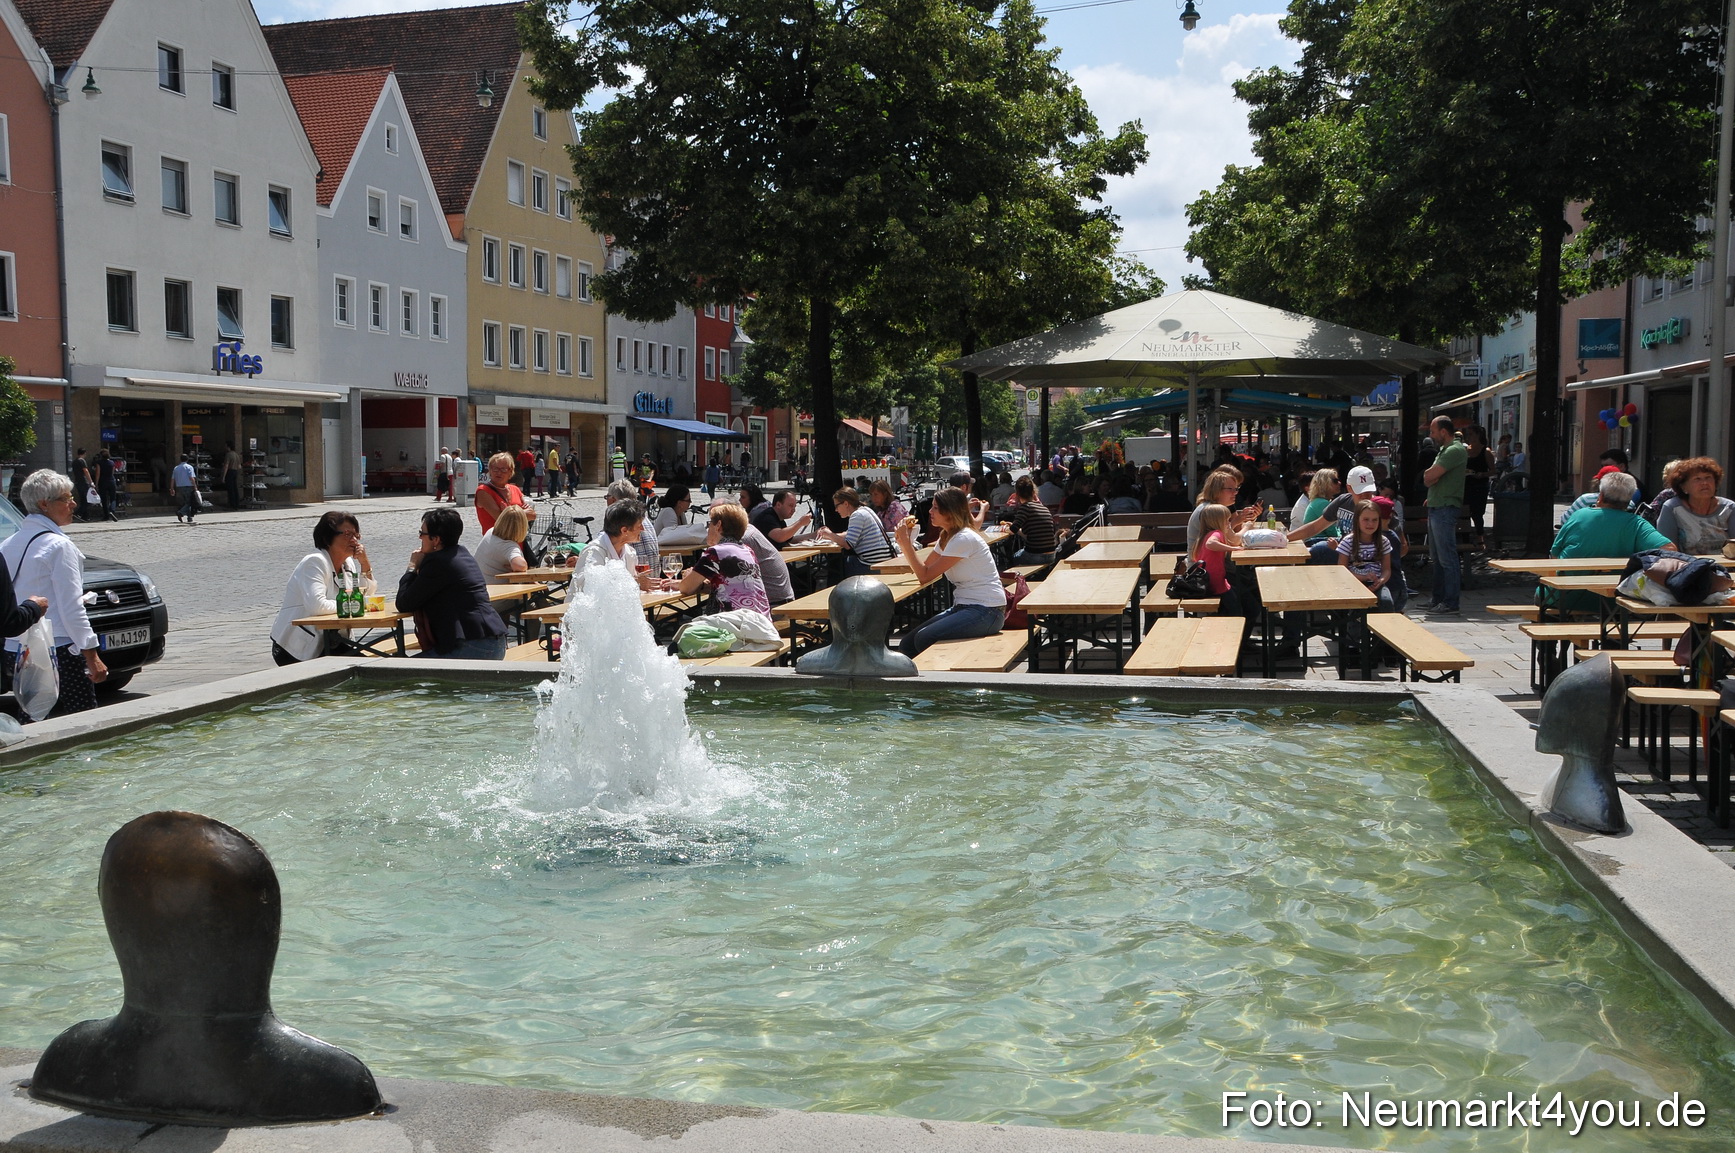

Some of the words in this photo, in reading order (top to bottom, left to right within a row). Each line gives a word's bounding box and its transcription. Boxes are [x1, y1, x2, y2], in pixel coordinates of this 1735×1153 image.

[1141, 341, 1242, 352] NEUMARKTER
[394, 372, 430, 389] Weltbild
[1359, 475, 1367, 484] N
[108, 634, 115, 648] N
